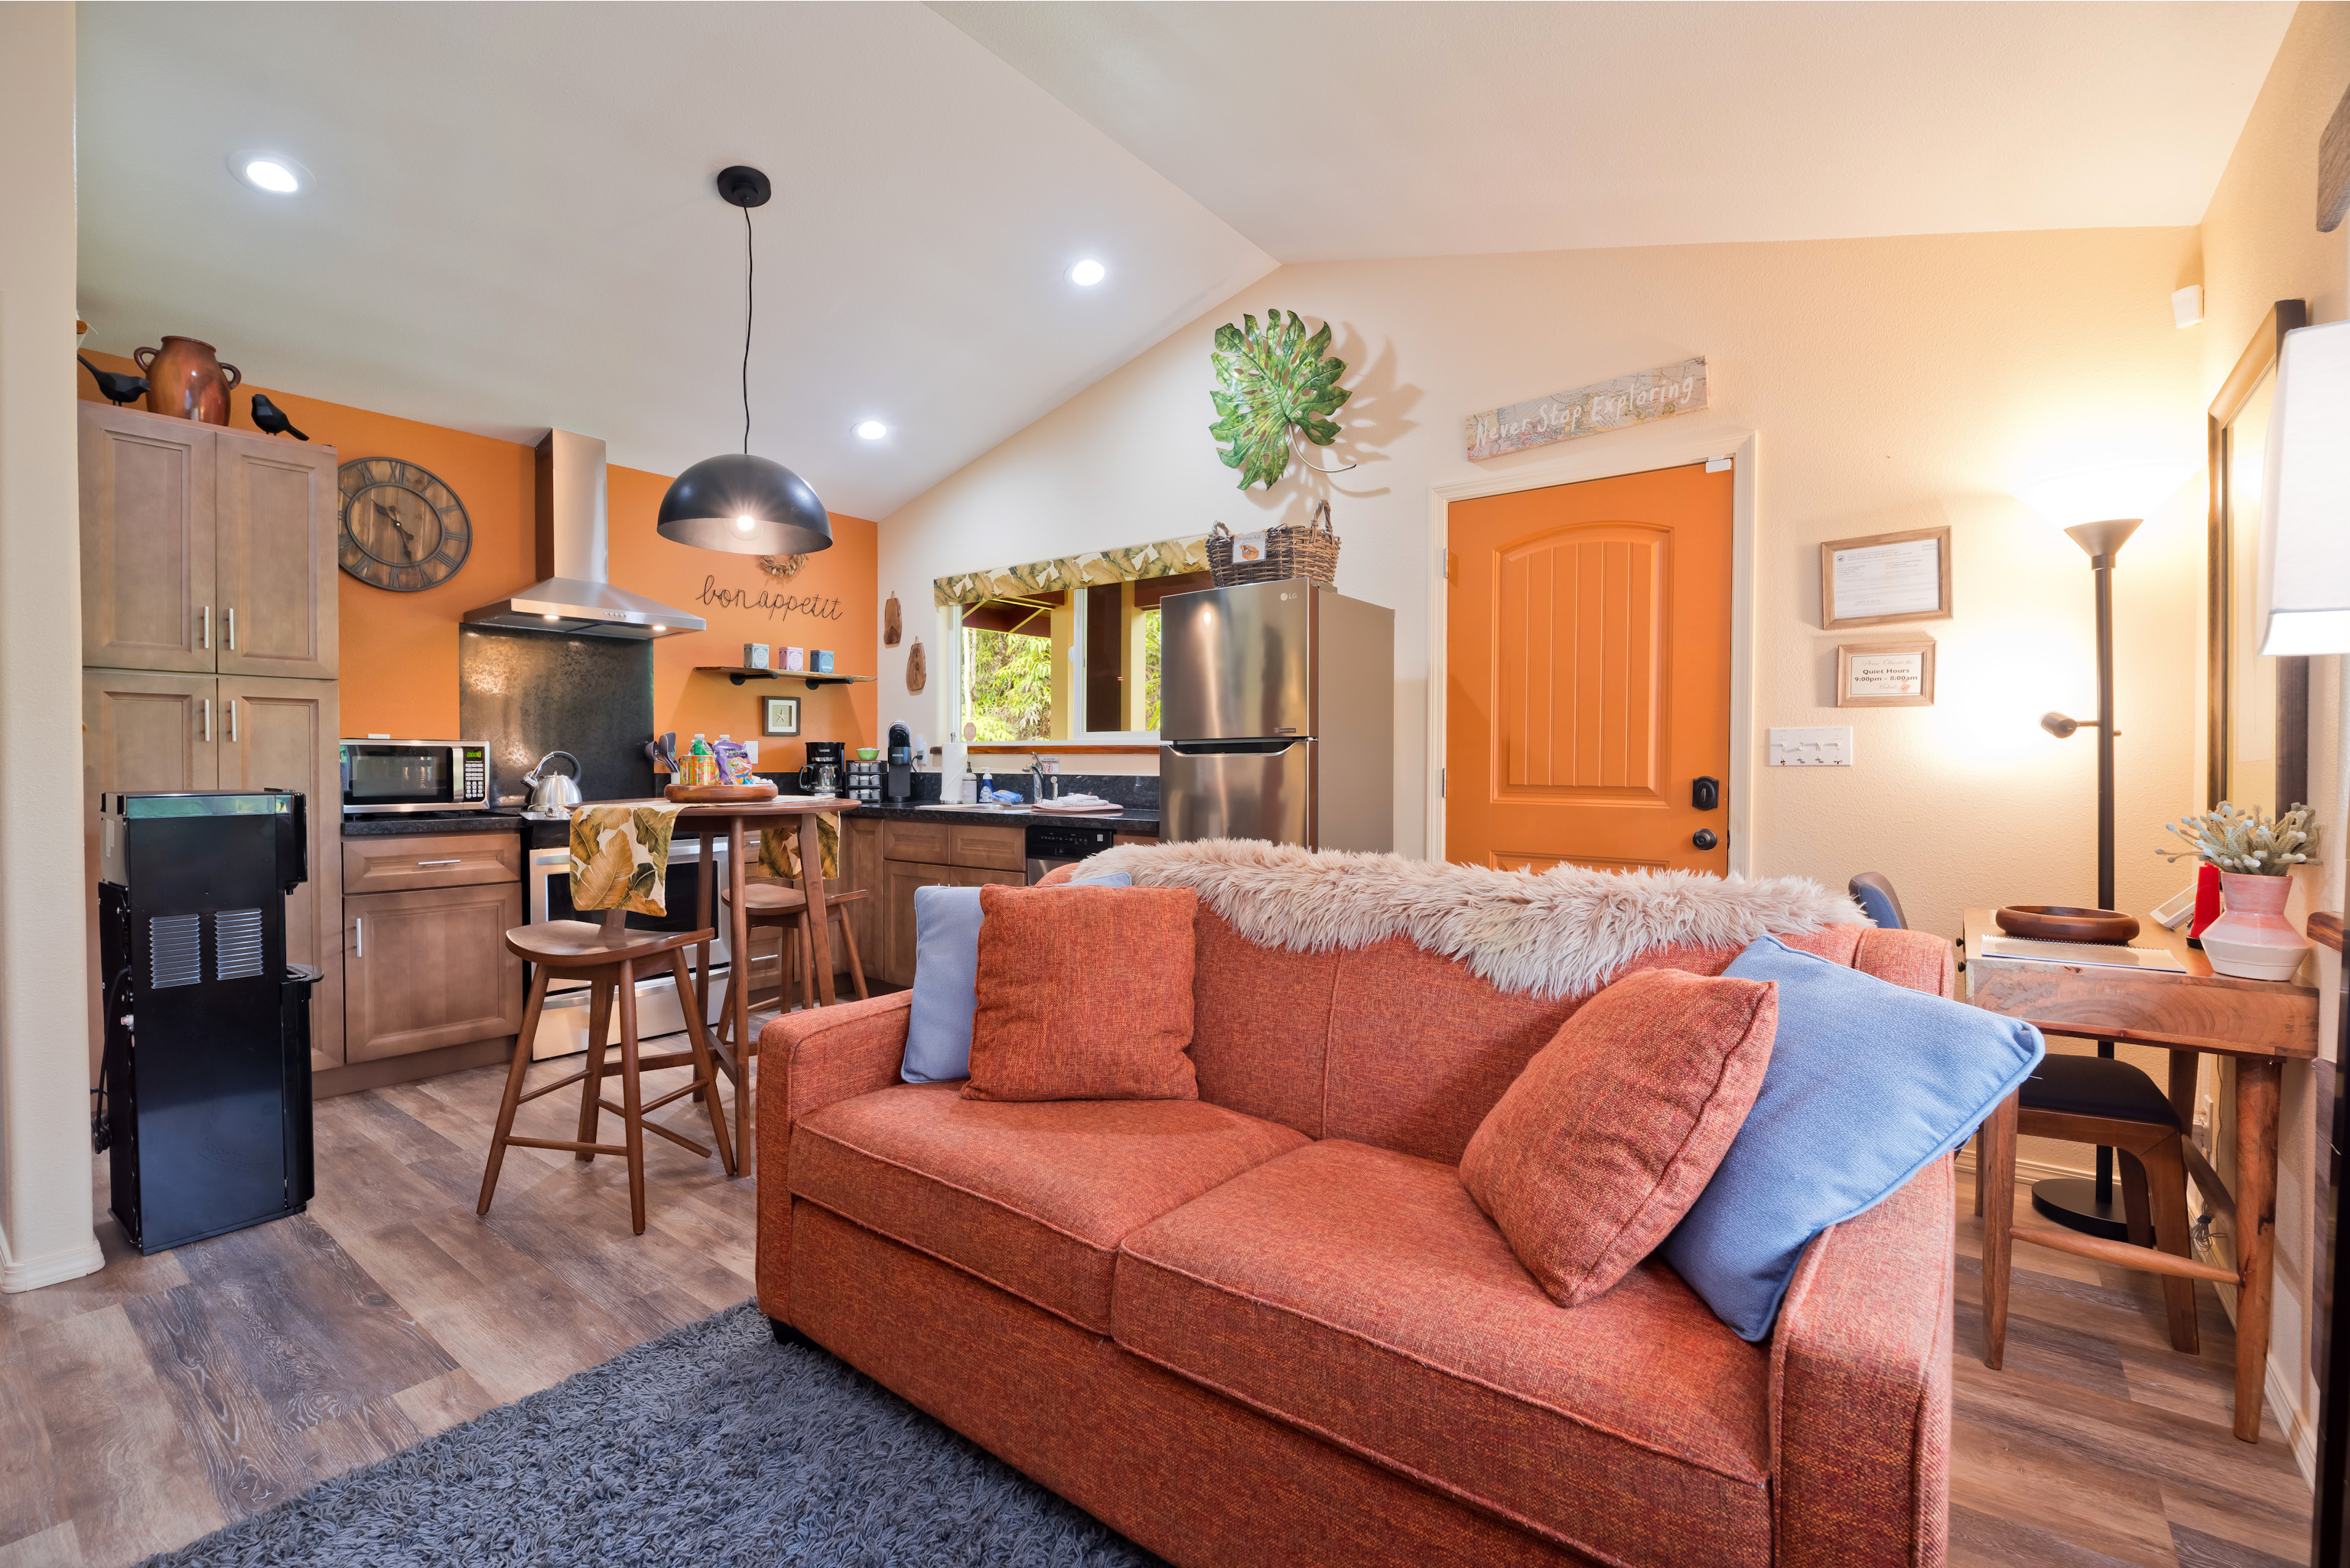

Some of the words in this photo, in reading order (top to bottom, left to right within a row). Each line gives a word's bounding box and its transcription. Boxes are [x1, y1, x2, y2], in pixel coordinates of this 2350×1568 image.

[1476, 418, 1530, 447] Never
[1538, 403, 1582, 432] Stop
[1590, 376, 1694, 421] Exploring
[695, 574, 757, 610] bon
[757, 590, 843, 622] appetit
